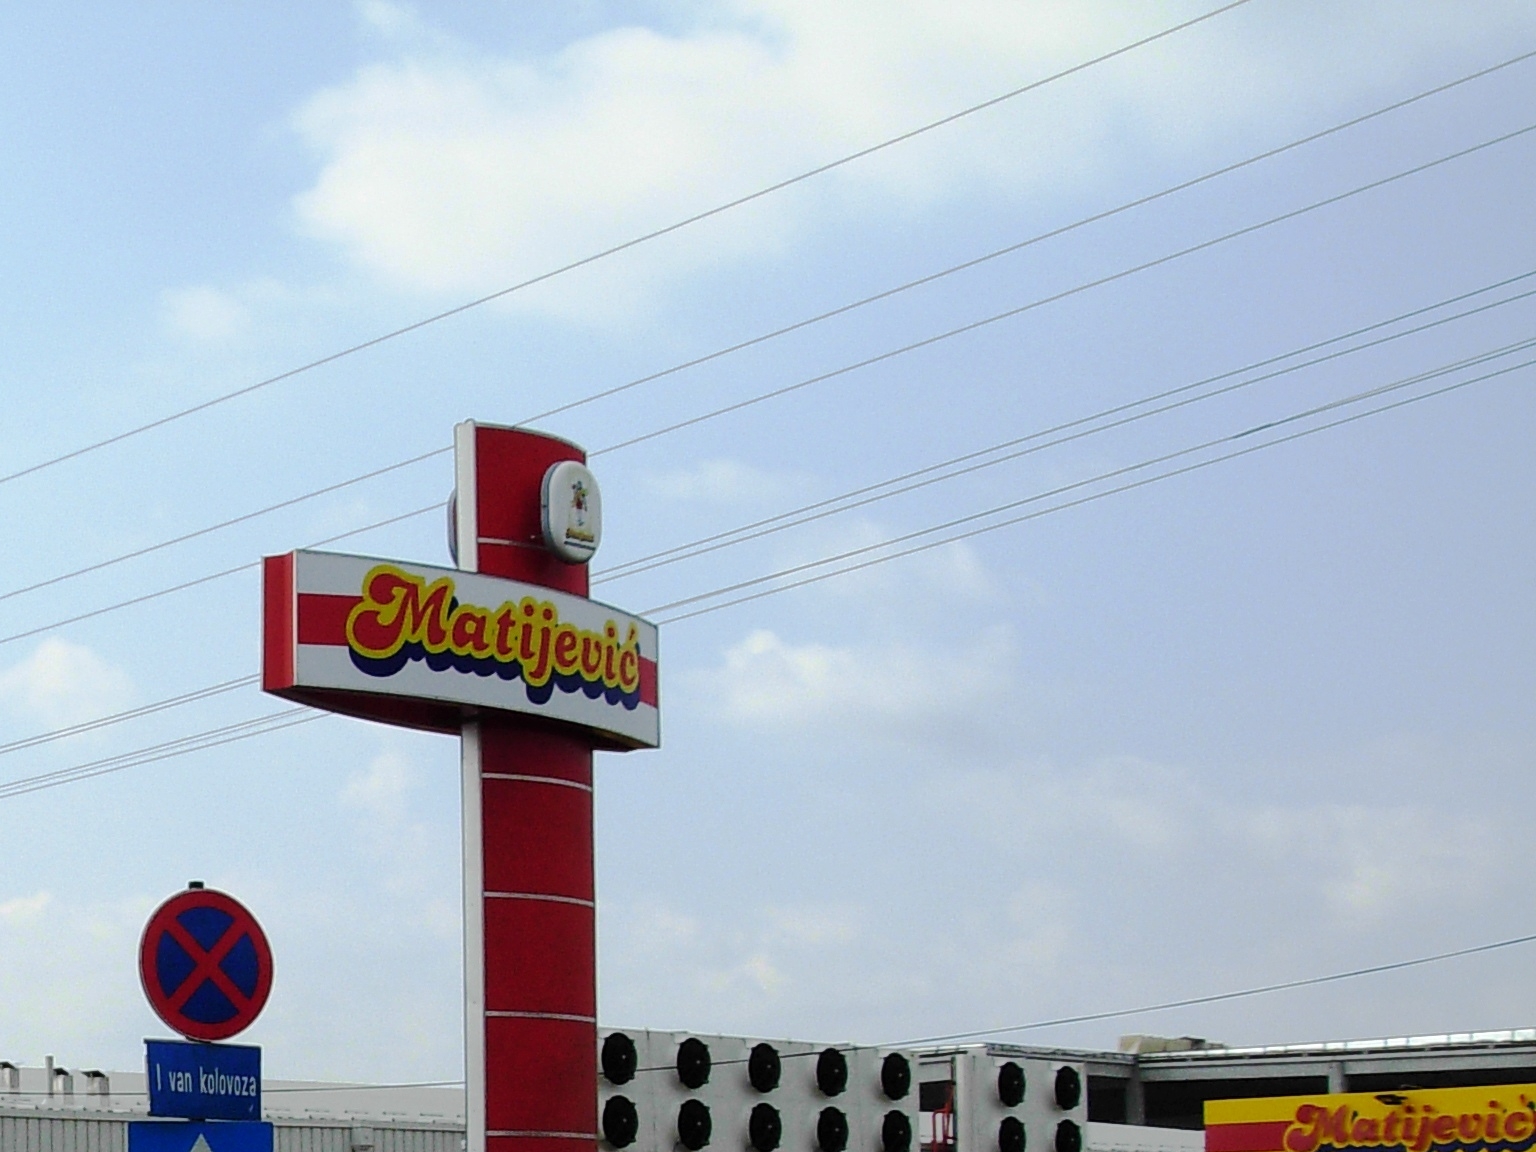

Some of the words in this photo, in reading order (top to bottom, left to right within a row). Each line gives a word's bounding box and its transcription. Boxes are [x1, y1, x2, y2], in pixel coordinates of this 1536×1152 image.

[346, 564, 640, 690] Matijević
[168, 1071, 193, 1093] van
[199, 1066, 257, 1097] kolovoza
